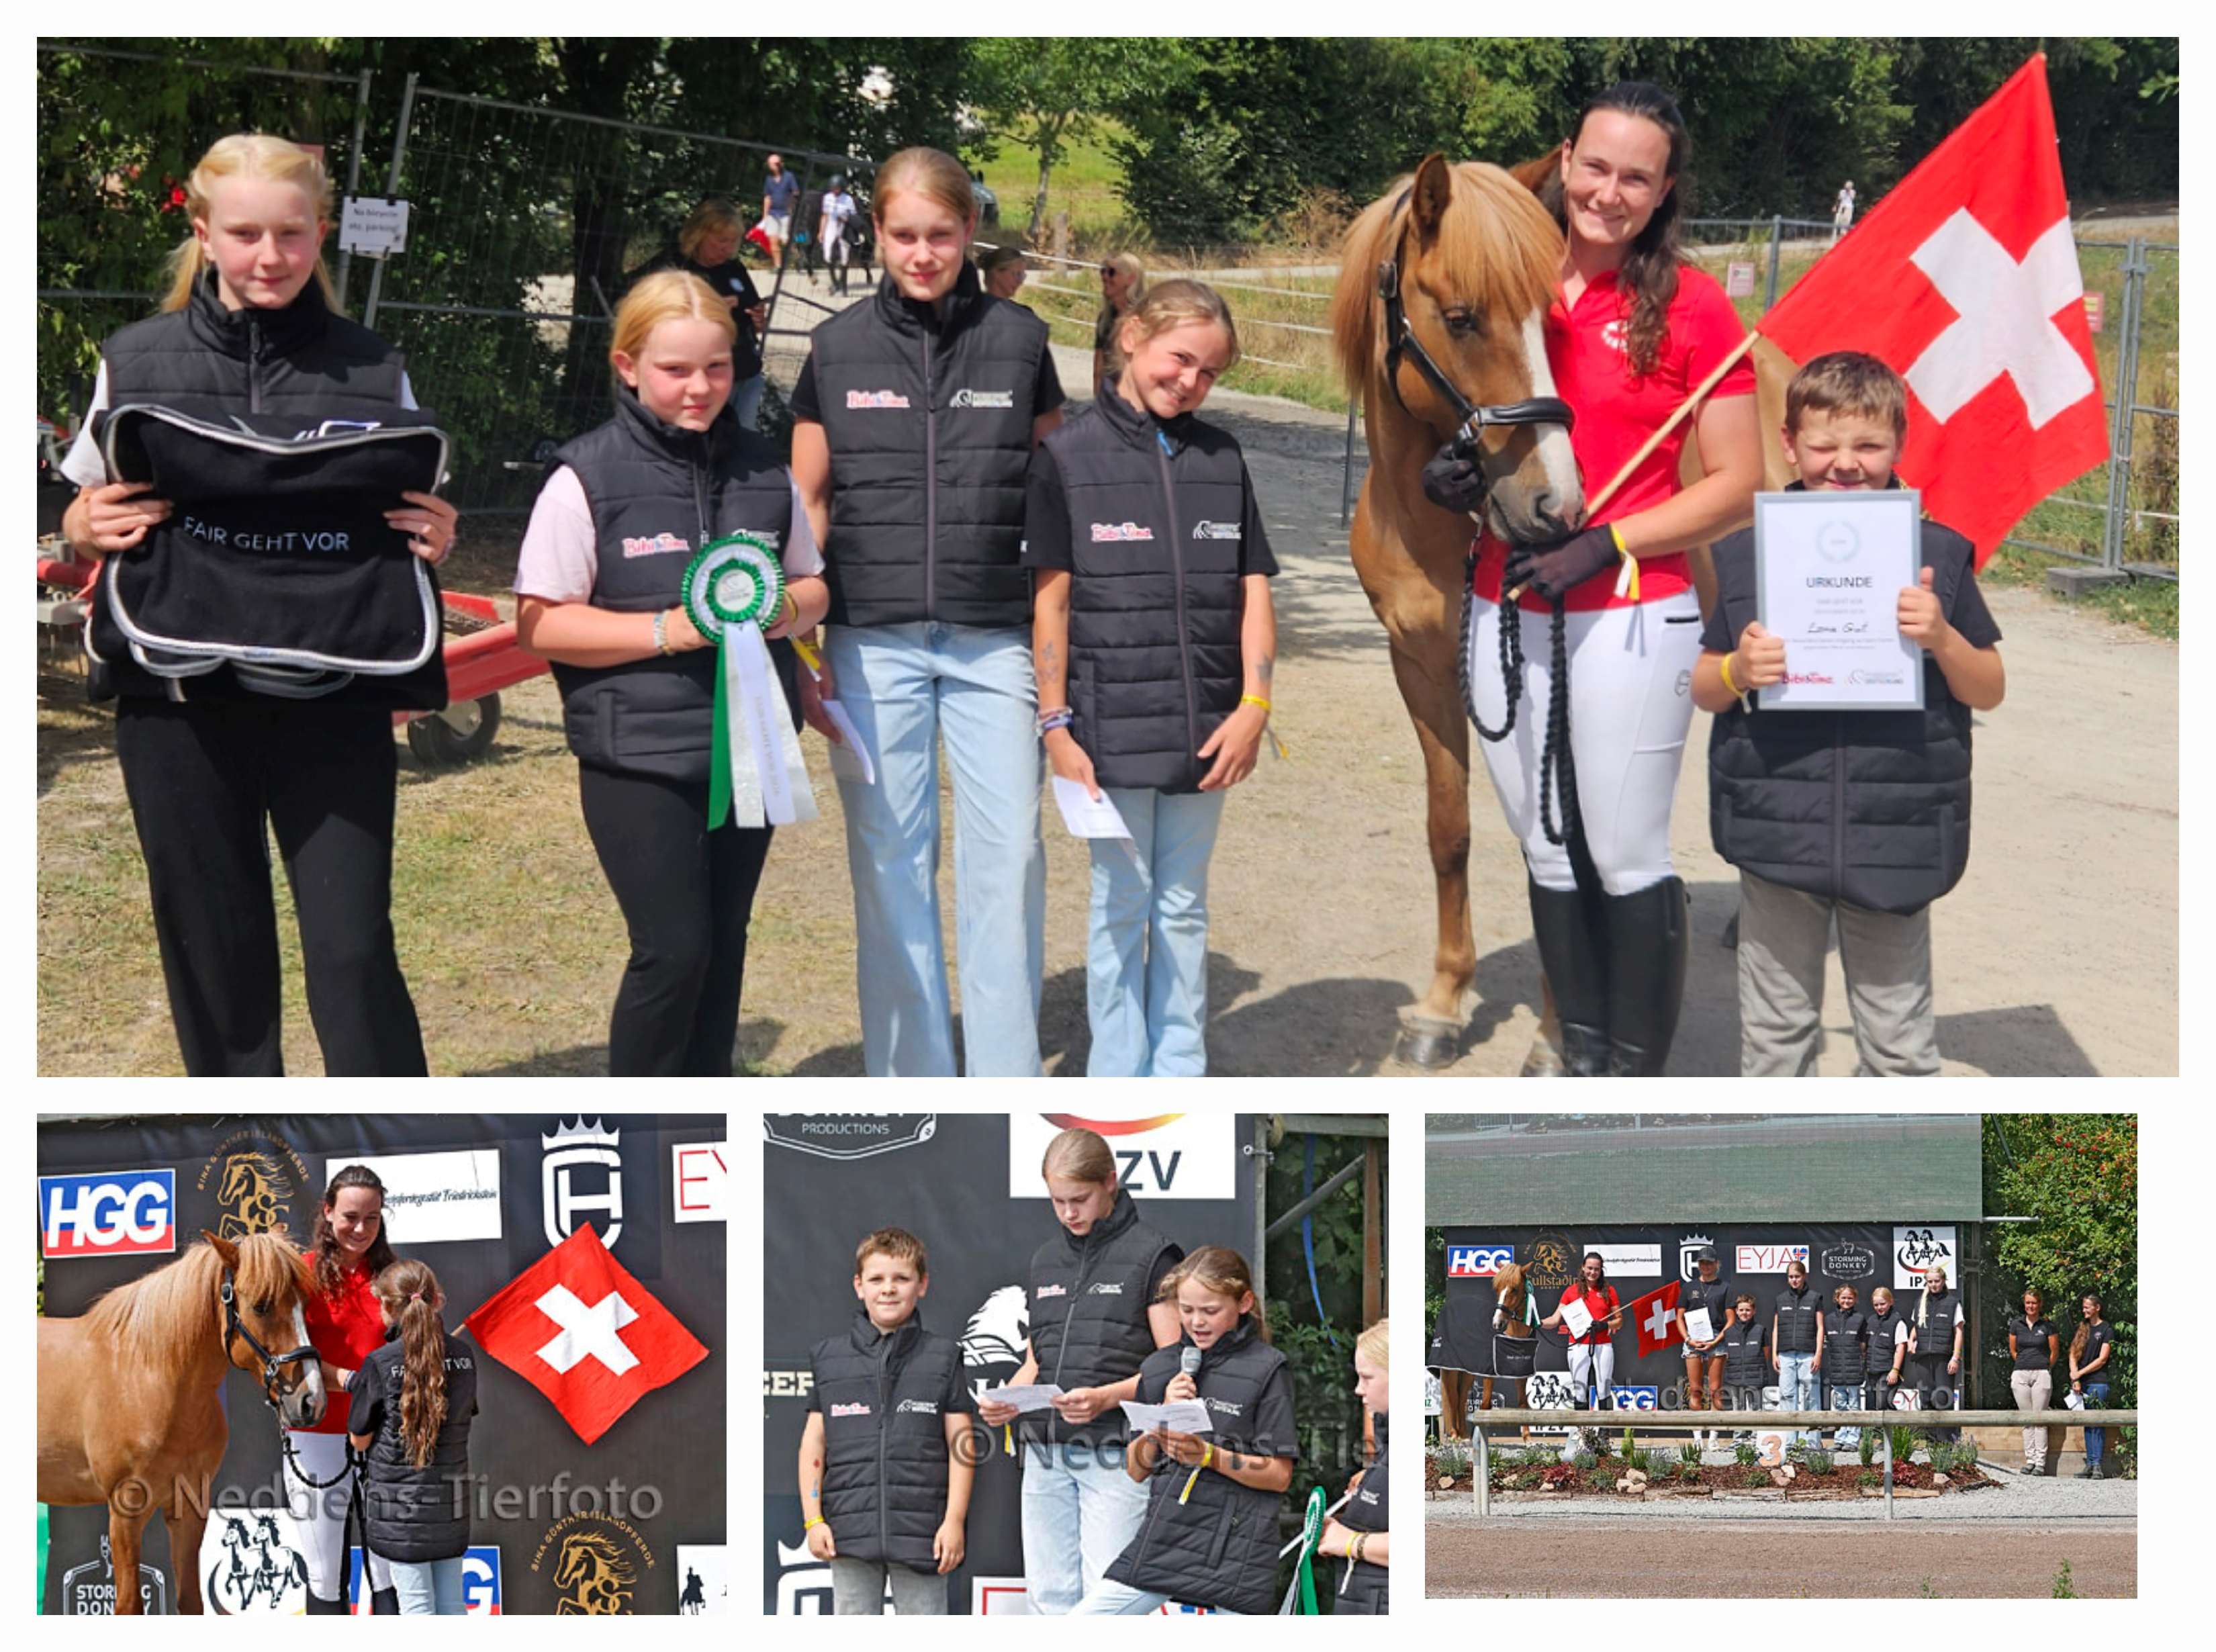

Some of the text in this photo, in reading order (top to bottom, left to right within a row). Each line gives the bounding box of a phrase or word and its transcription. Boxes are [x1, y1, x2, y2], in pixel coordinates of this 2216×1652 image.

[184, 516, 349, 551] FAIR GEHT VOR
[1806, 577, 1873, 588] URKUNDE
[801, 1122, 890, 1134] PRODUCTIONS
[1115, 1150, 1181, 1191] ZV
[47, 1180, 169, 1248] HGG
[1451, 1249, 1511, 1274] HGG
[1737, 1247, 1794, 1270] EYJA
[1910, 1276, 1928, 1287] IP
[1758, 1434, 1782, 1467] 3
[77, 1584, 151, 1600] STORG
[77, 1601, 151, 1615] DONY
